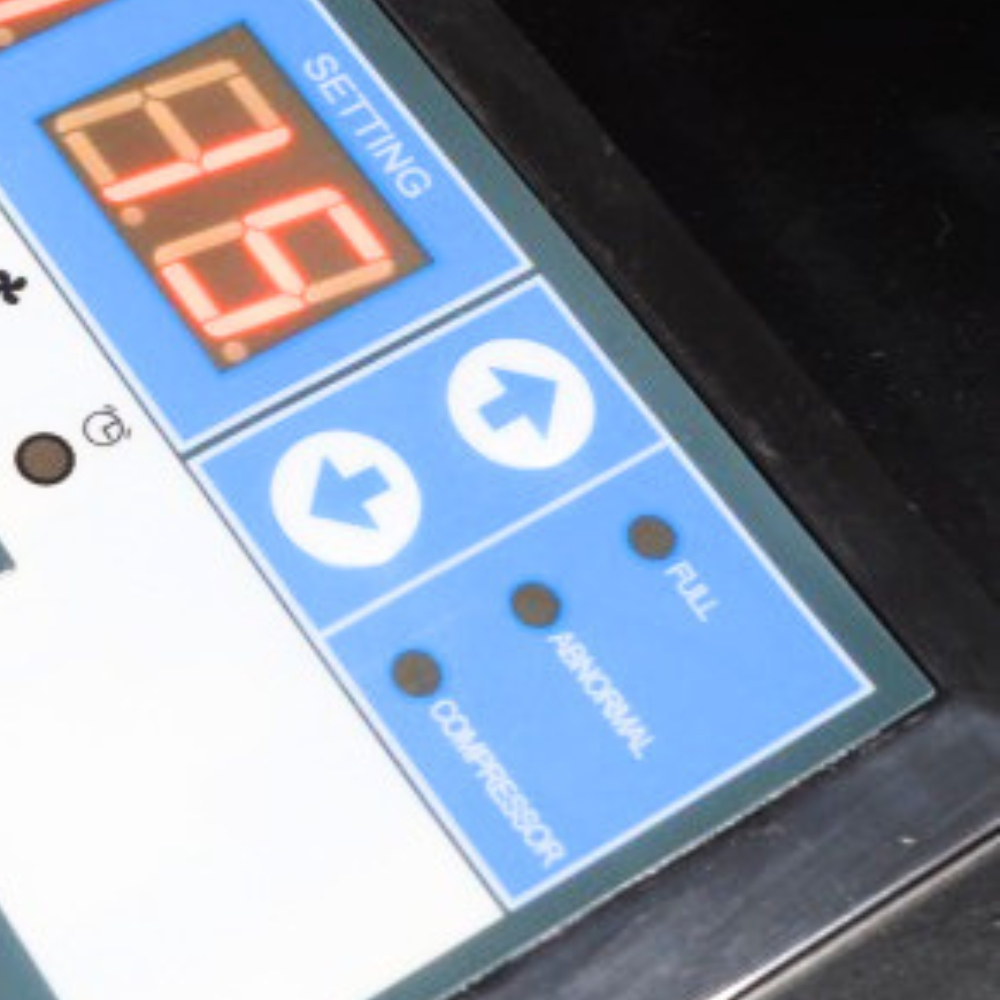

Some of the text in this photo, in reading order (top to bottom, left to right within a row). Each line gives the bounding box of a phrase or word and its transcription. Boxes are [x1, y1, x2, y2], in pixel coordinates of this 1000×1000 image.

[304, 51, 433, 203] SETTING
[665, 560, 721, 622] FULL
[546, 631, 656, 760] ABNORMAL
[429, 698, 567, 868] COMPRESSOR
